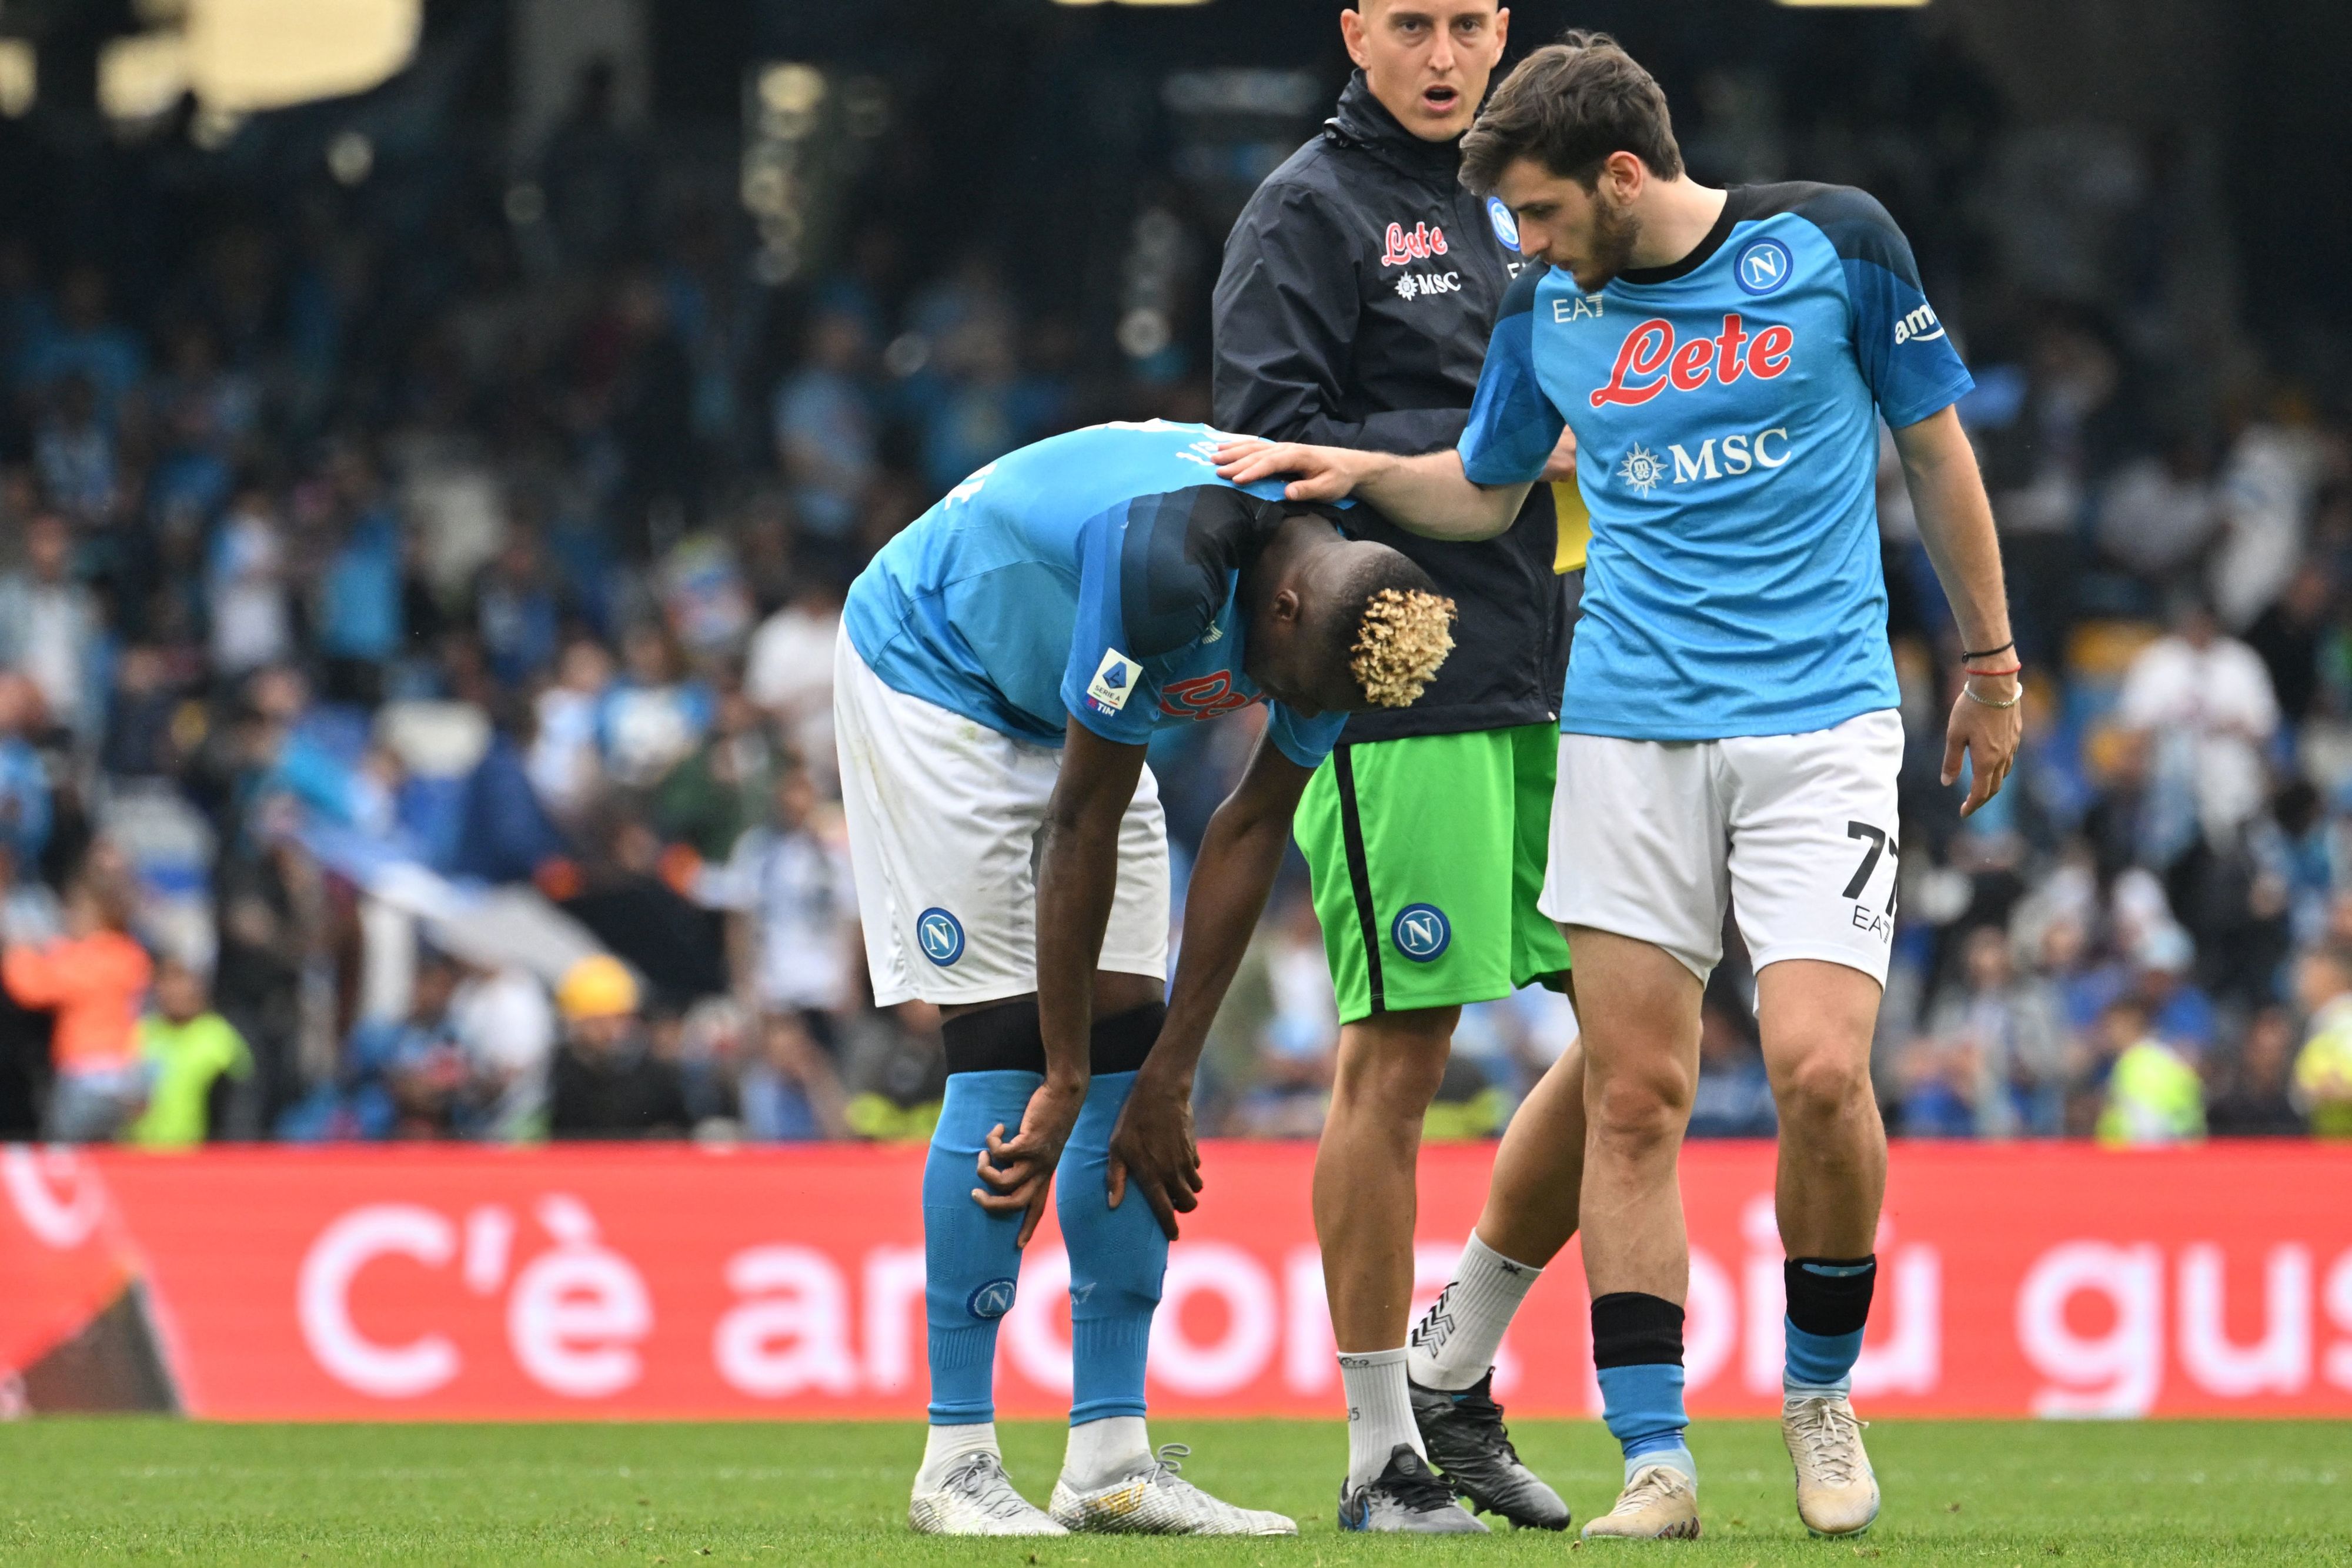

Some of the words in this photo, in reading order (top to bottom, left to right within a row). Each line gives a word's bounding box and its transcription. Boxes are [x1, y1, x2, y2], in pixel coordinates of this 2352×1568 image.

[1381, 221, 1448, 266] Lete
[1749, 251, 1776, 283] N
[1415, 272, 1461, 295] MSC
[1895, 304, 1937, 345] am
[1589, 313, 1794, 408] Lete
[1668, 427, 1792, 484] MSC
[1095, 685, 1115, 698] SERIE
[1097, 703, 1115, 717] TIM
[925, 922, 950, 950] N
[1405, 917, 1433, 947] N
[296, 1192, 654, 1399] C'è
[713, 1239, 1523, 1400] ancor
[2013, 1238, 2352, 1420] gu
[984, 1288, 1010, 1311] N
